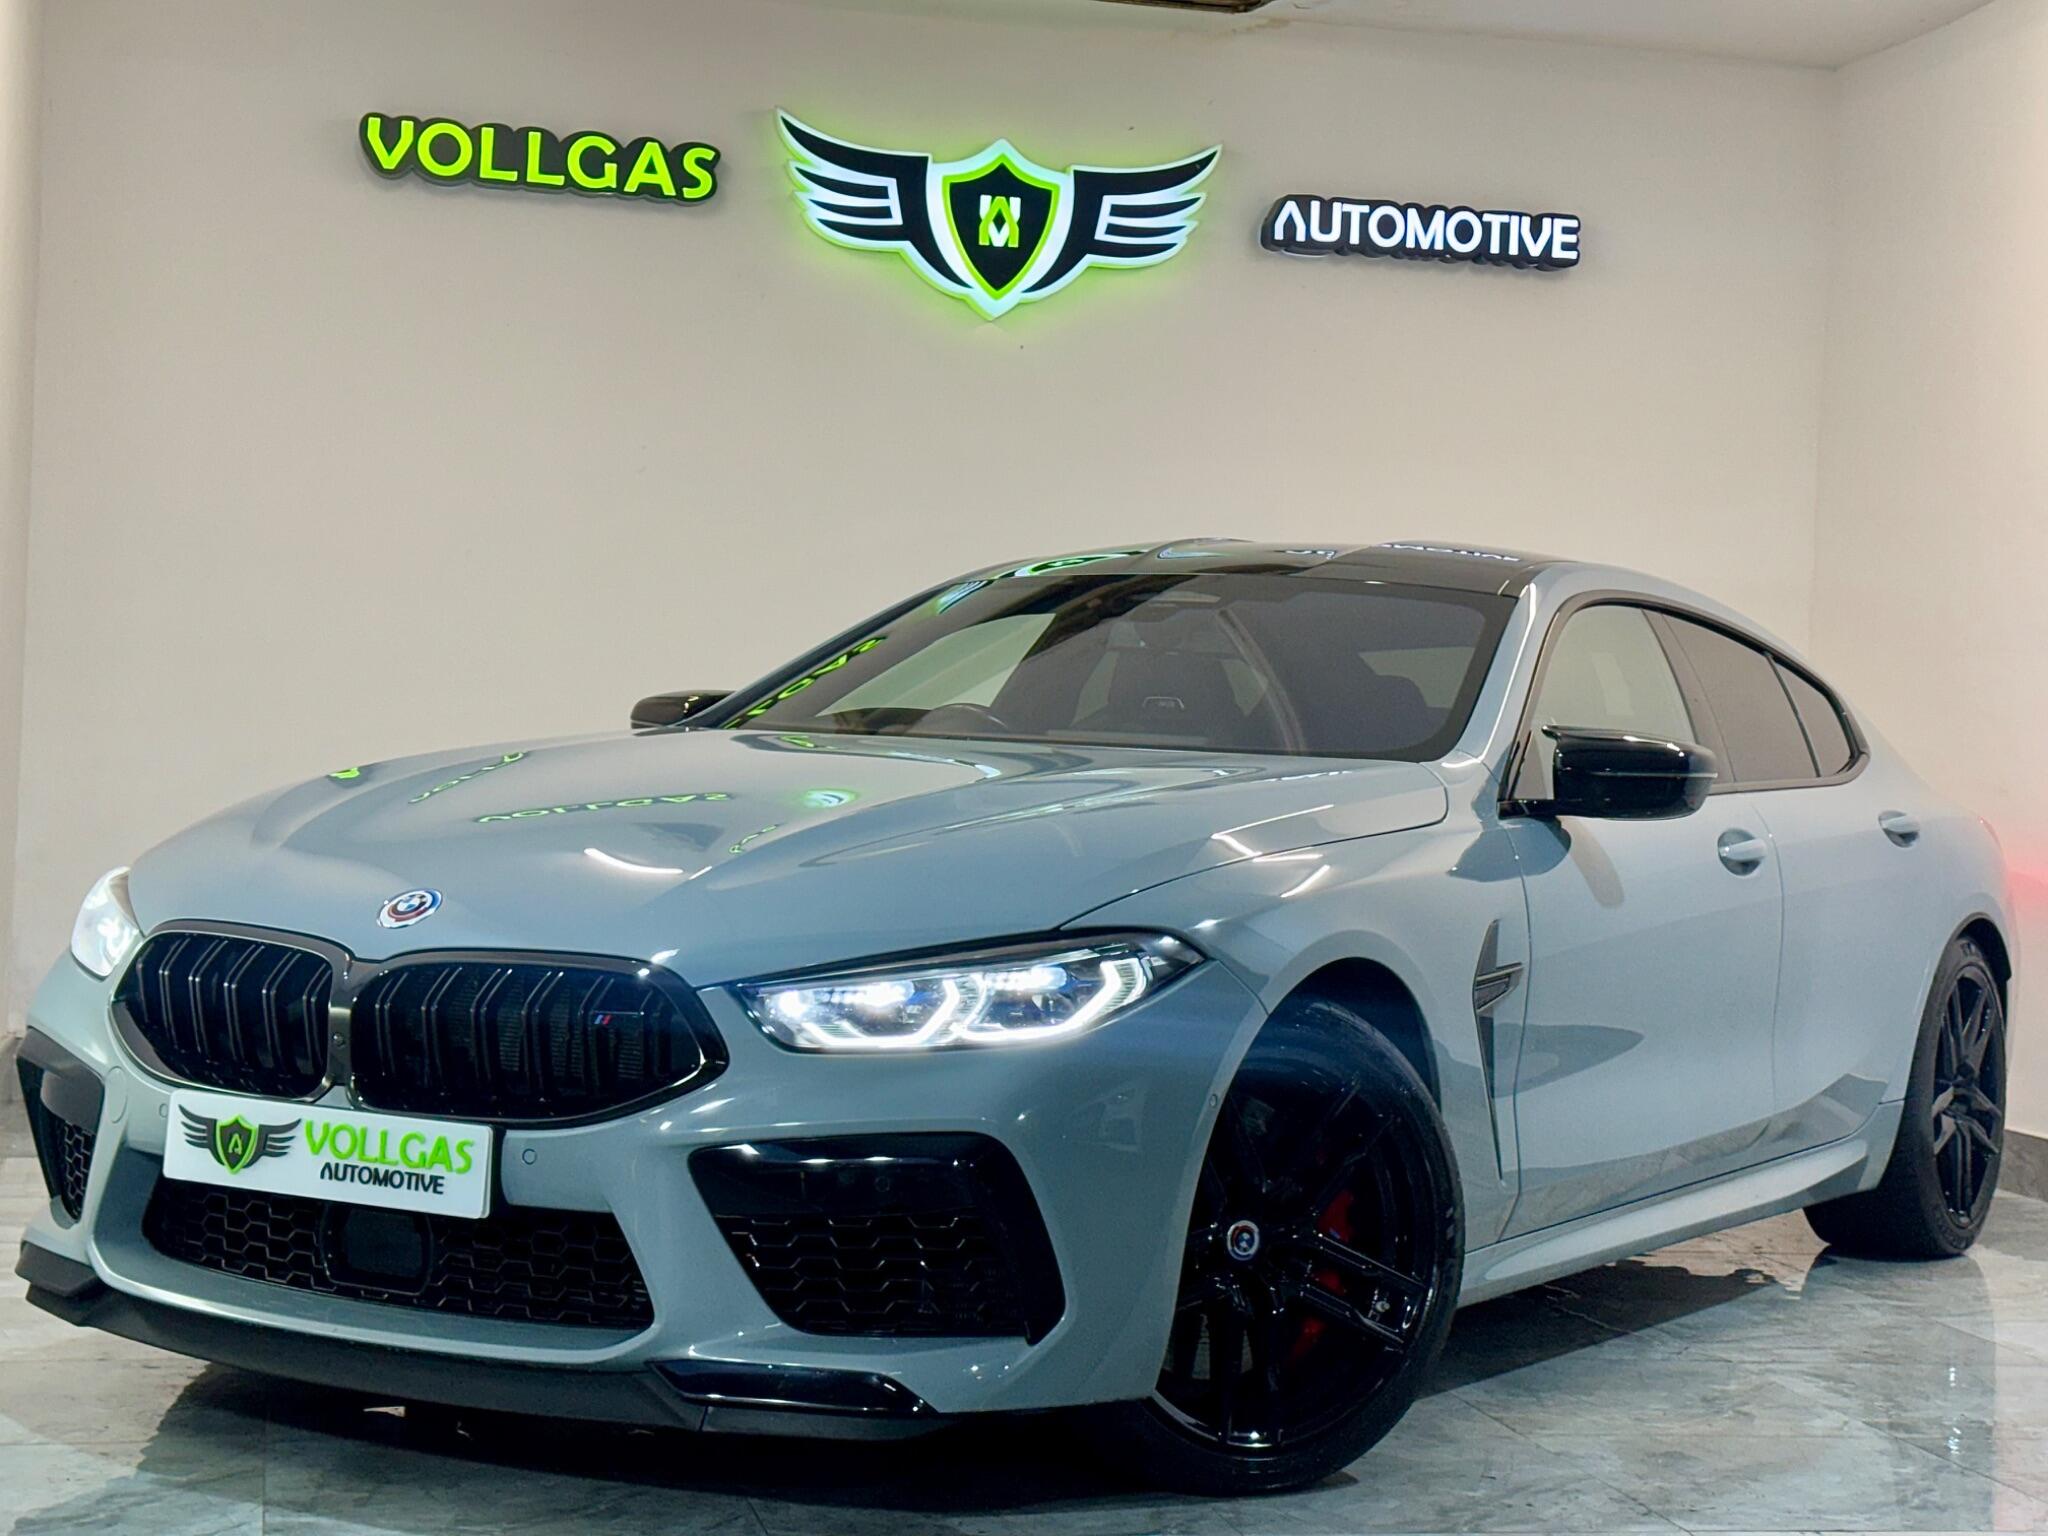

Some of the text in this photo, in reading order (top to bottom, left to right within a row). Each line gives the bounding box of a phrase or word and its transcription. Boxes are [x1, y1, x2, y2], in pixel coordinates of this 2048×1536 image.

[367, 117, 715, 199] VOLLGAS
[1273, 200, 1579, 259] AUTOMOTIVE
[305, 1119, 475, 1174] VOLLGAS
[320, 1162, 445, 1195] AUTOMOTIVE
